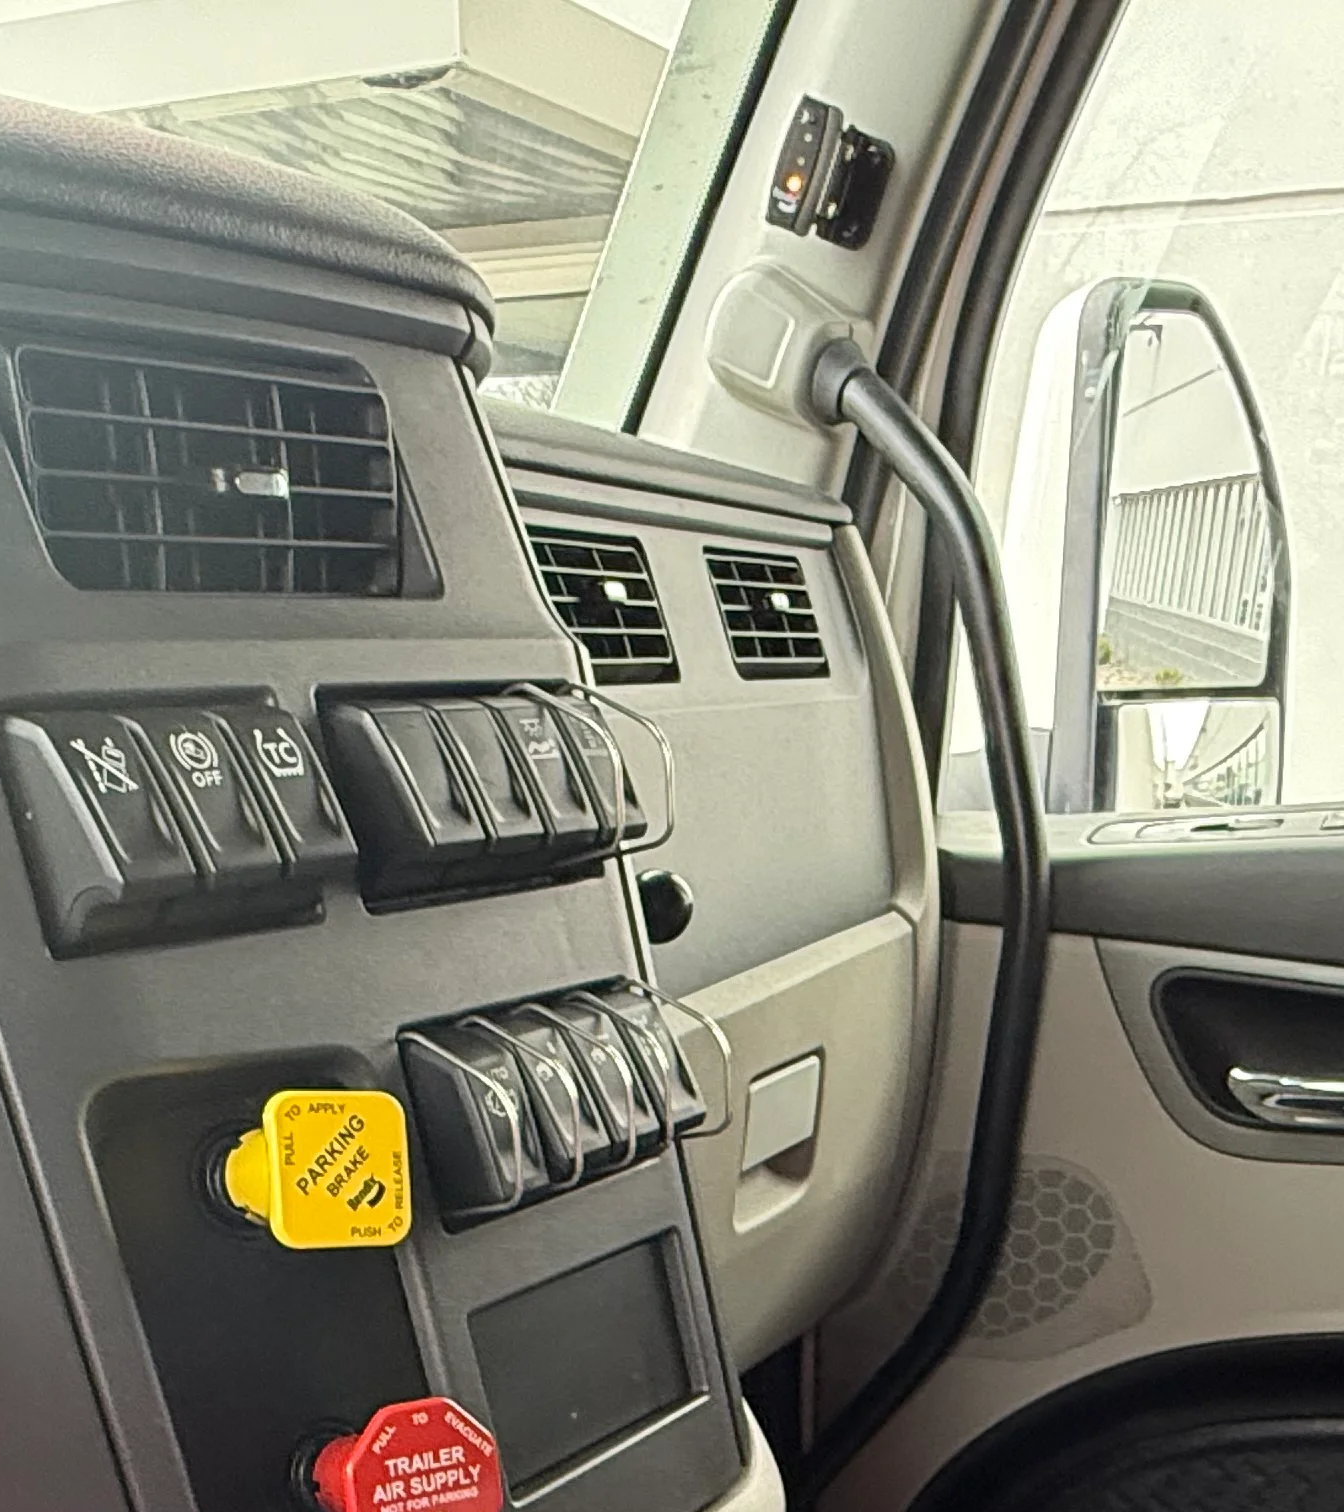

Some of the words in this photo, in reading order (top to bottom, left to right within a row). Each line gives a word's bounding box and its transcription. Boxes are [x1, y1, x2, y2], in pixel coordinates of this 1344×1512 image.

[262, 741, 298, 765] TC
[191, 769, 224, 788] OFF
[284, 1104, 302, 1122] TO
[307, 1102, 346, 1116] APPLY
[284, 1132, 296, 1166] PULL
[295, 1114, 366, 1196] PARKING
[325, 1145, 370, 1198] BRAKE
[392, 1151, 404, 1210] RELEASE
[350, 1226, 382, 1238] PUSH
[388, 1214, 404, 1233] TO
[372, 1425, 397, 1454] PULL
[411, 1412, 429, 1425] TO
[444, 1411, 494, 1457] EVACUATE
[384, 1445, 466, 1478] TRAILER
[373, 1480, 405, 1504] AIR
[409, 1464, 482, 1496] SUPPLY
[406, 1496, 430, 1512] FOR
[431, 1486, 479, 1507] PARKING
